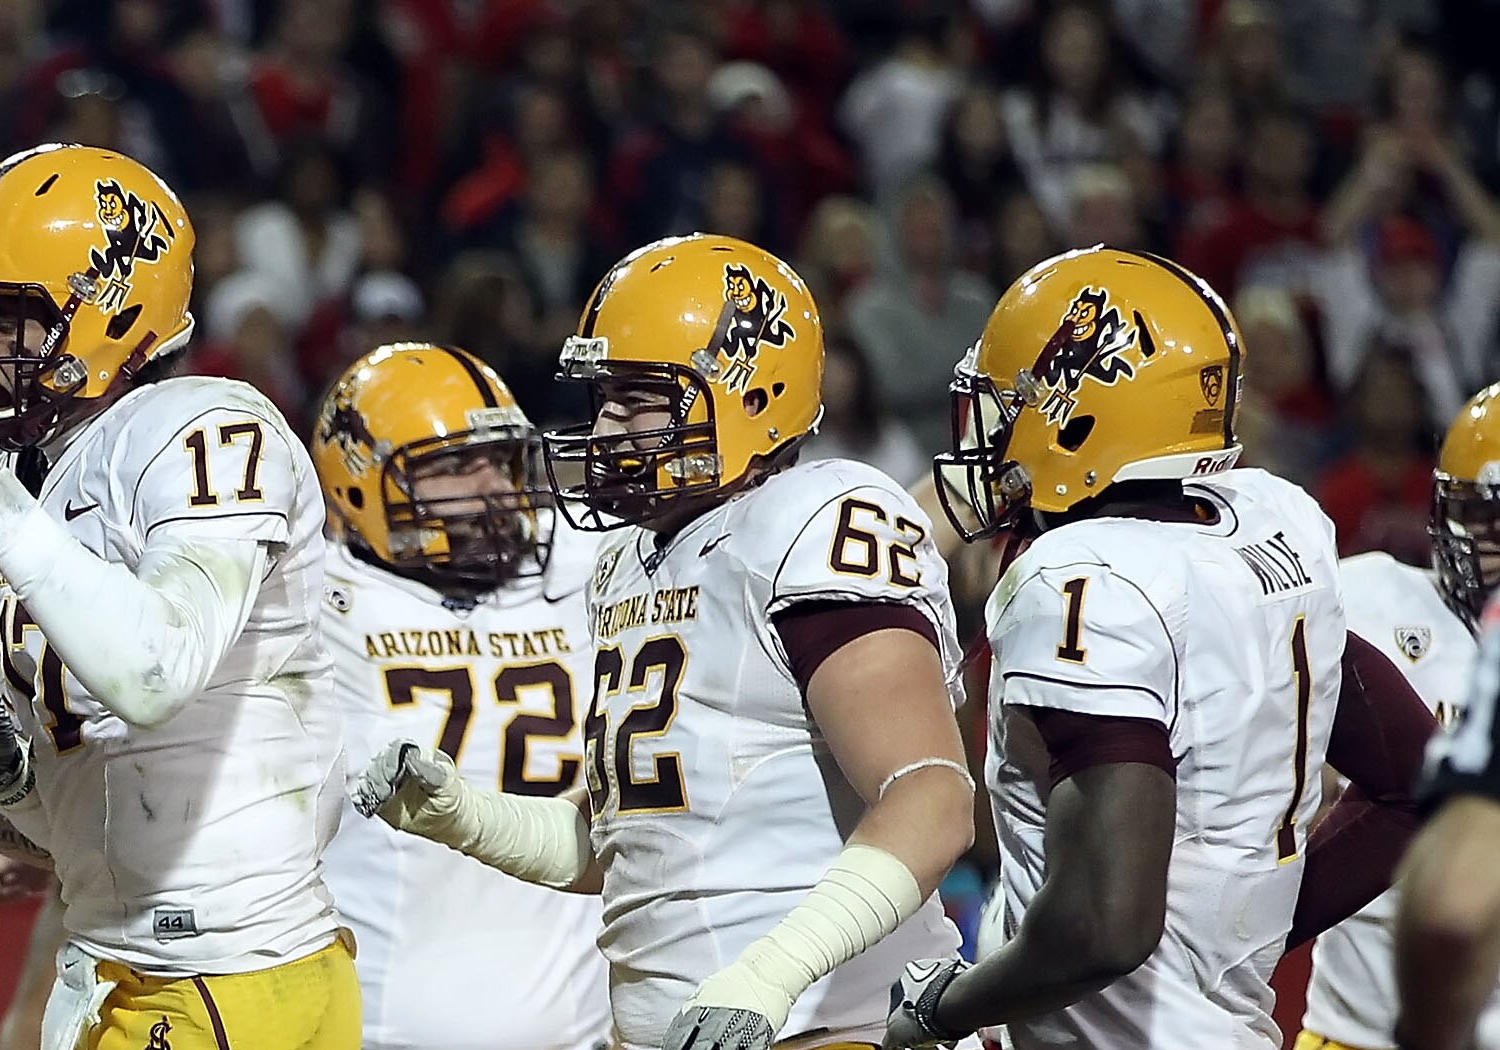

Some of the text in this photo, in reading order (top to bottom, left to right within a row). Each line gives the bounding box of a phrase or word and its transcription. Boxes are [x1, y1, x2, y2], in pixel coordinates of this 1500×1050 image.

[183, 420, 267, 509] 17
[827, 496, 926, 588] 62
[364, 627, 572, 659] ARIZONA STATE
[651, 584, 700, 625] STATE
[1055, 575, 1090, 665] 1
[380, 657, 584, 797] 72
[583, 633, 692, 821] 62
[1276, 612, 1314, 866] 1
[158, 915, 183, 930] 44
